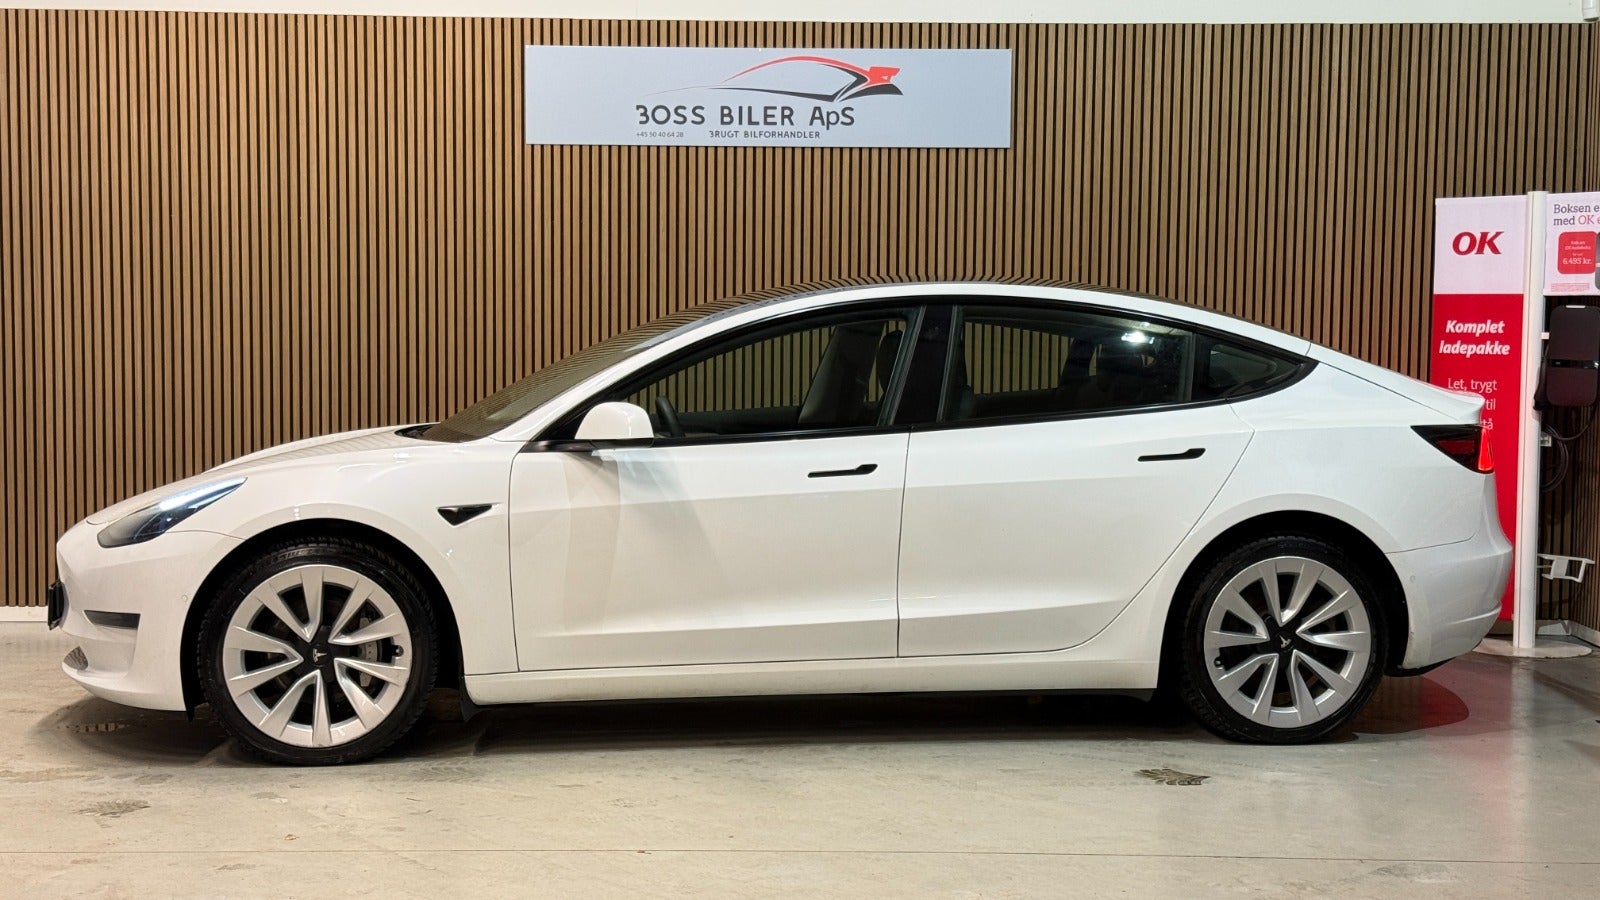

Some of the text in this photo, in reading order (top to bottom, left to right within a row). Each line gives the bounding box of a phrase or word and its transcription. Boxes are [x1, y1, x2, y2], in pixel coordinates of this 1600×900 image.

[636, 104, 855, 130] BOSS BILER ApS
[709, 130, 821, 139] BRUGT BILFORHANDLER
[1553, 203, 1591, 214] Boksen
[1553, 215, 1575, 226] med
[1578, 214, 1594, 225] OK
[1452, 231, 1504, 255] OK
[1446, 319, 1505, 337] Komplet
[1439, 340, 1510, 358] ladepakke
[1448, 378, 1497, 393] Let, trygt
[1485, 398, 1496, 411] til
